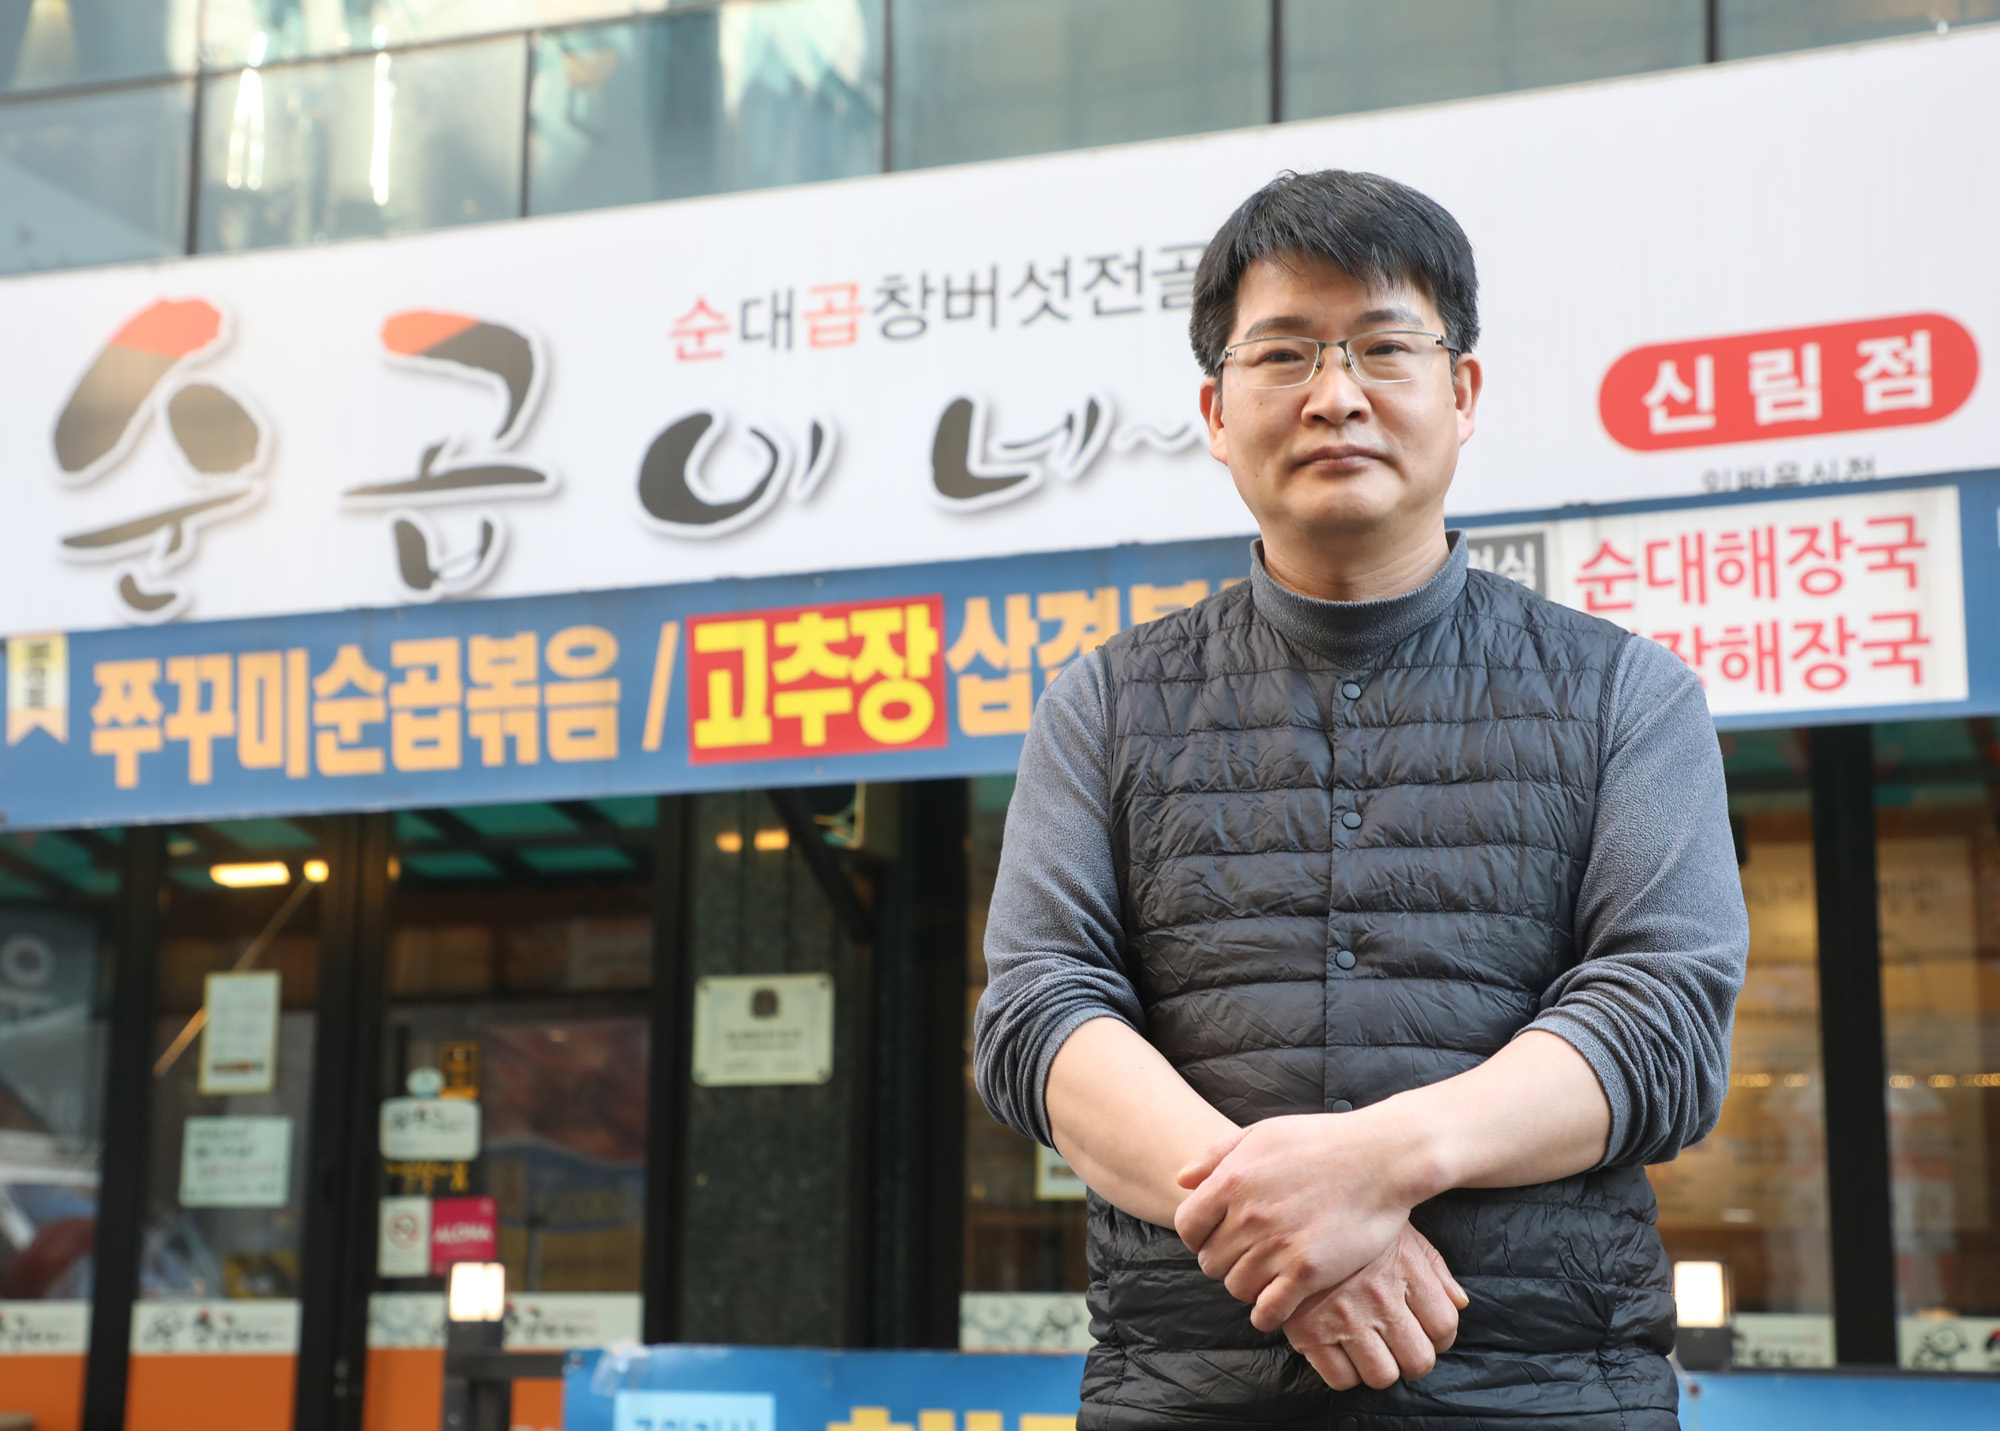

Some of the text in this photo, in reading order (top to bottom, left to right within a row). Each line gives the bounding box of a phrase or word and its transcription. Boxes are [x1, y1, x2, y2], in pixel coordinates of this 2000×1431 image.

[667, 240, 1208, 364] 순대곱창버섯전골
[1640, 329, 1935, 435] 신림점
[1574, 514, 1928, 612] 순대해장국
[90, 625, 622, 790] 쭈꾸미순곱볶음
